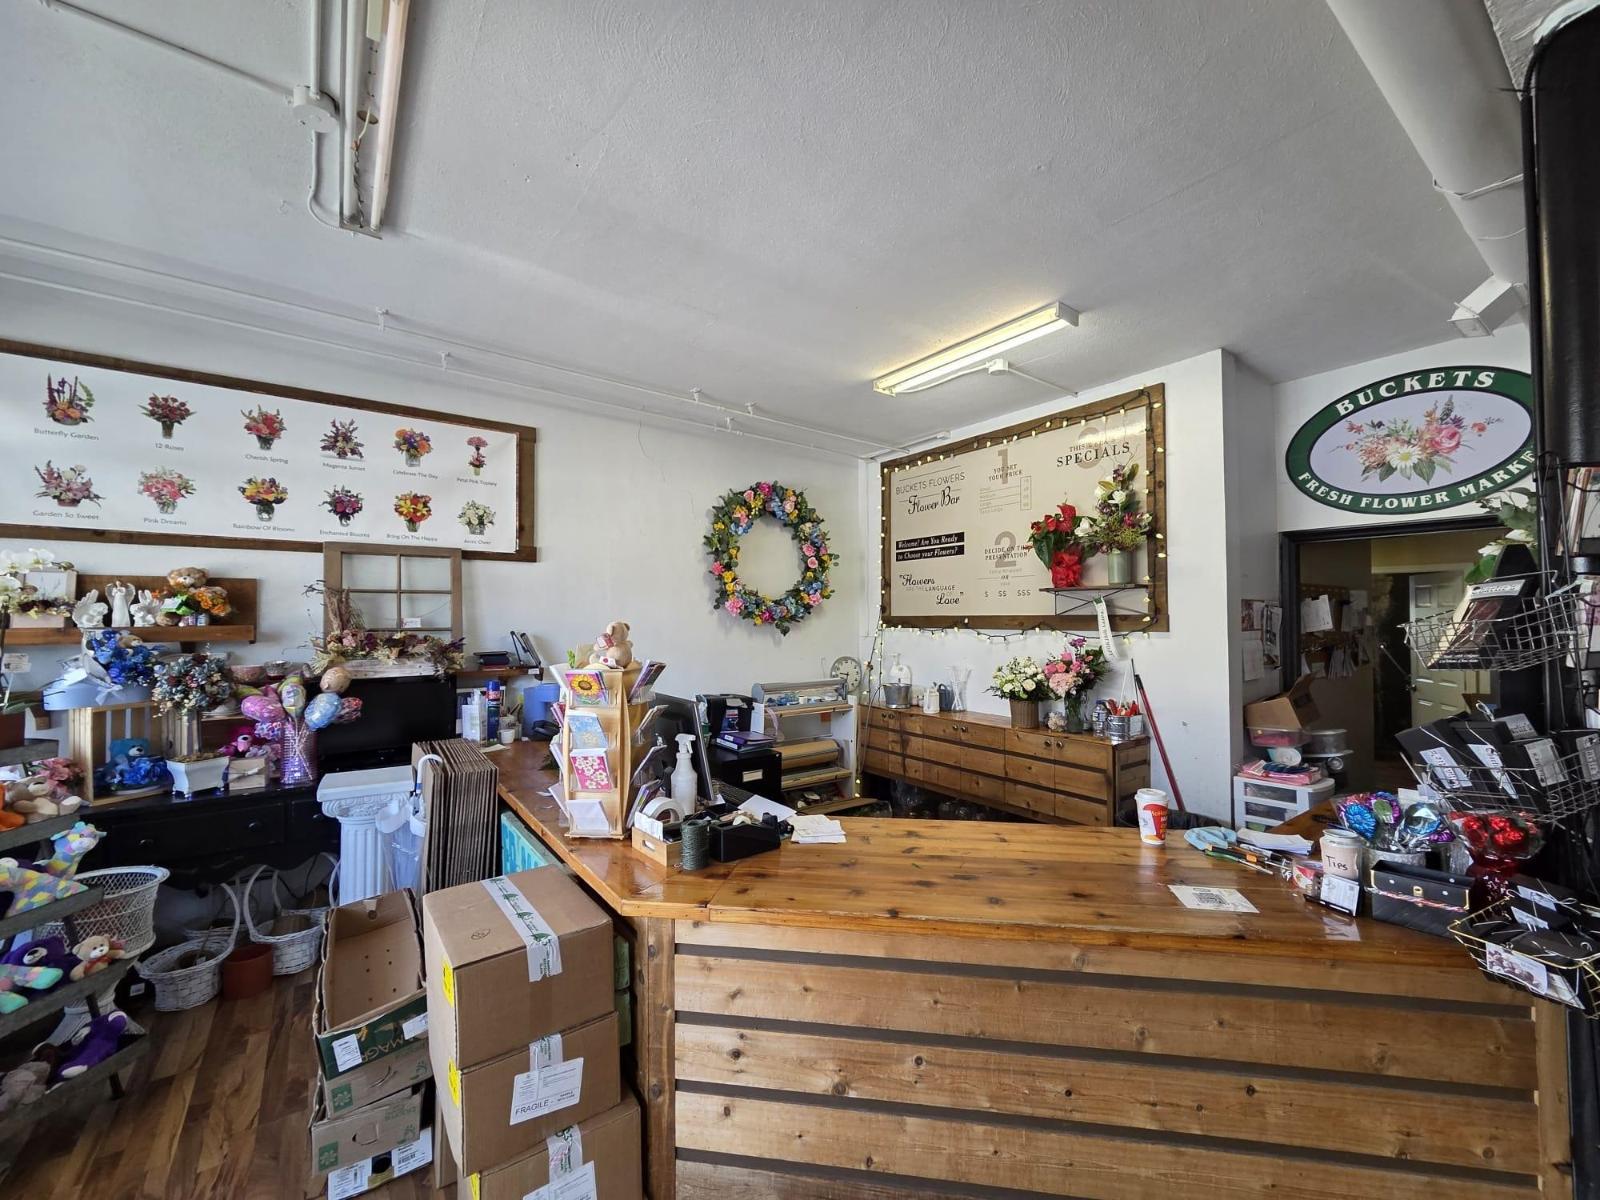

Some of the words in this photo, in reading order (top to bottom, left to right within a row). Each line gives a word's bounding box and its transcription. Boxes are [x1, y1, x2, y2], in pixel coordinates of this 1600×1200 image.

[1335, 370, 1496, 416] BUCKETS
[34, 427, 68, 438] Butterfly
[70, 432, 99, 441] Garden
[1056, 441, 1130, 467] SPECIALS
[896, 481, 927, 495] BUCKETS
[929, 472, 965, 487] FLOWERS
[1298, 472, 1353, 506] FRESH
[1360, 491, 1450, 509] FLOWER
[1457, 447, 1535, 498] MARKE
[908, 495, 938, 514] Flower
[941, 486, 960, 507] Bar
[32, 510, 63, 519] Garden
[76, 512, 99, 520] Sweet
[930, 537, 940, 545] You
[941, 535, 958, 543] Ready
[934, 546, 958, 556] Flowers?
[985, 546, 1005, 554] DECIDE
[985, 552, 1028, 560] PRESENTATION
[995, 531, 1016, 568] 2
[1326, 854, 1348, 871] Tips
[515, 1099, 549, 1115] FRAGILE
